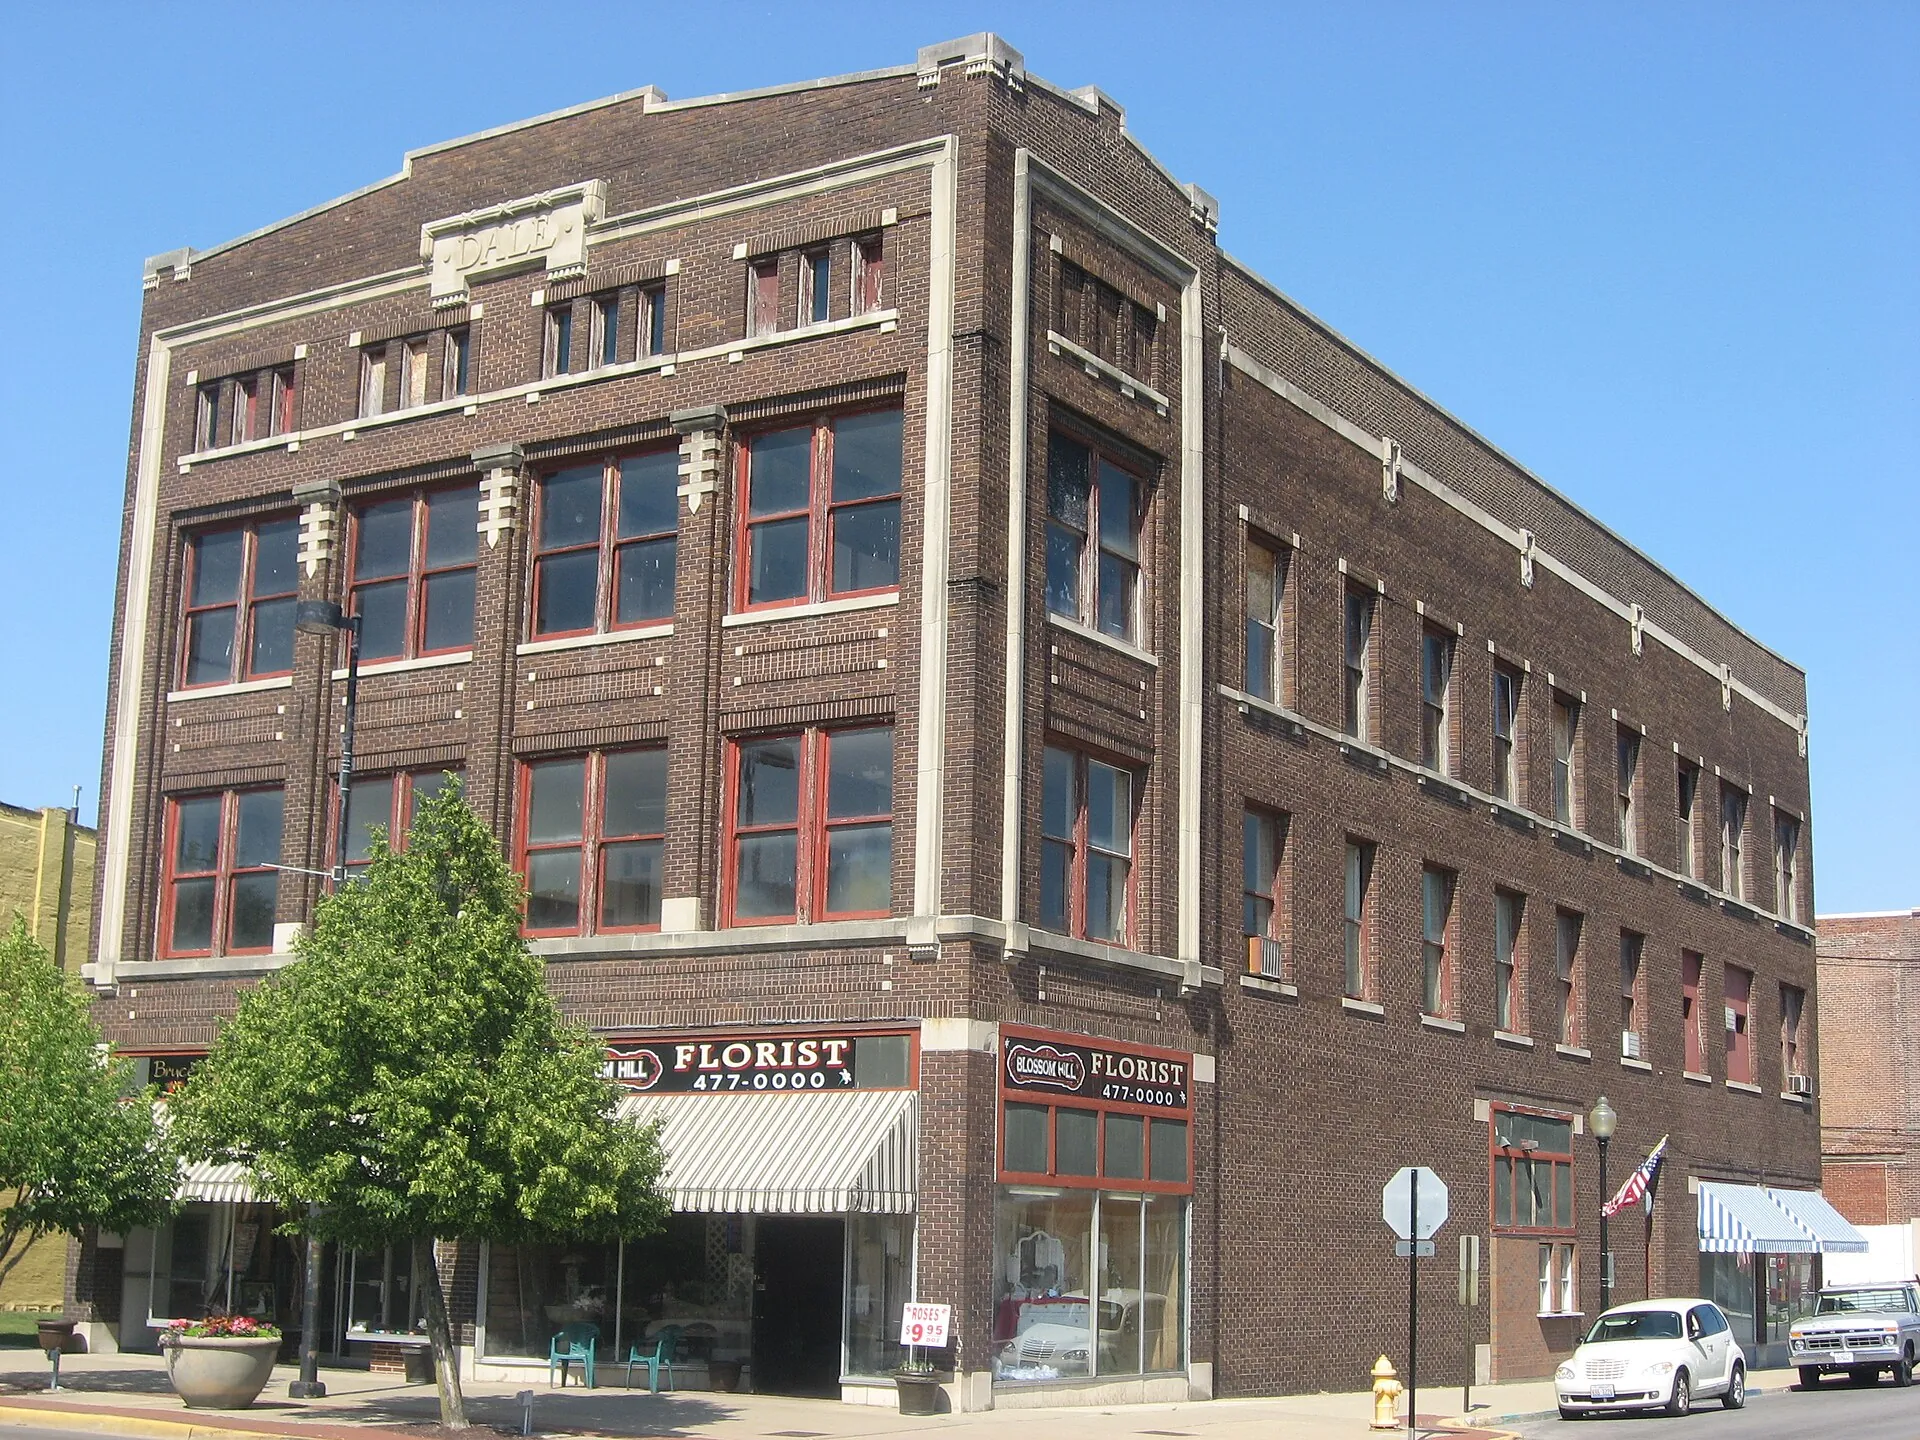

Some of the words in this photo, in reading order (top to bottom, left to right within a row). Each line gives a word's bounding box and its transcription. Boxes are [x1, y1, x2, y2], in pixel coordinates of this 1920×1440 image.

[455, 213, 559, 271] DALE
[674, 1040, 848, 1071] FLORIST
[617, 1060, 647, 1078] HILL
[1016, 1056, 1057, 1077] BLOSSOM
[1057, 1061, 1077, 1080] HILL
[1090, 1052, 1183, 1086] FLORIST
[693, 1072, 825, 1091] 477-0000
[1102, 1084, 1173, 1106] 477-0000
[911, 1307, 940, 1321] ROSES
